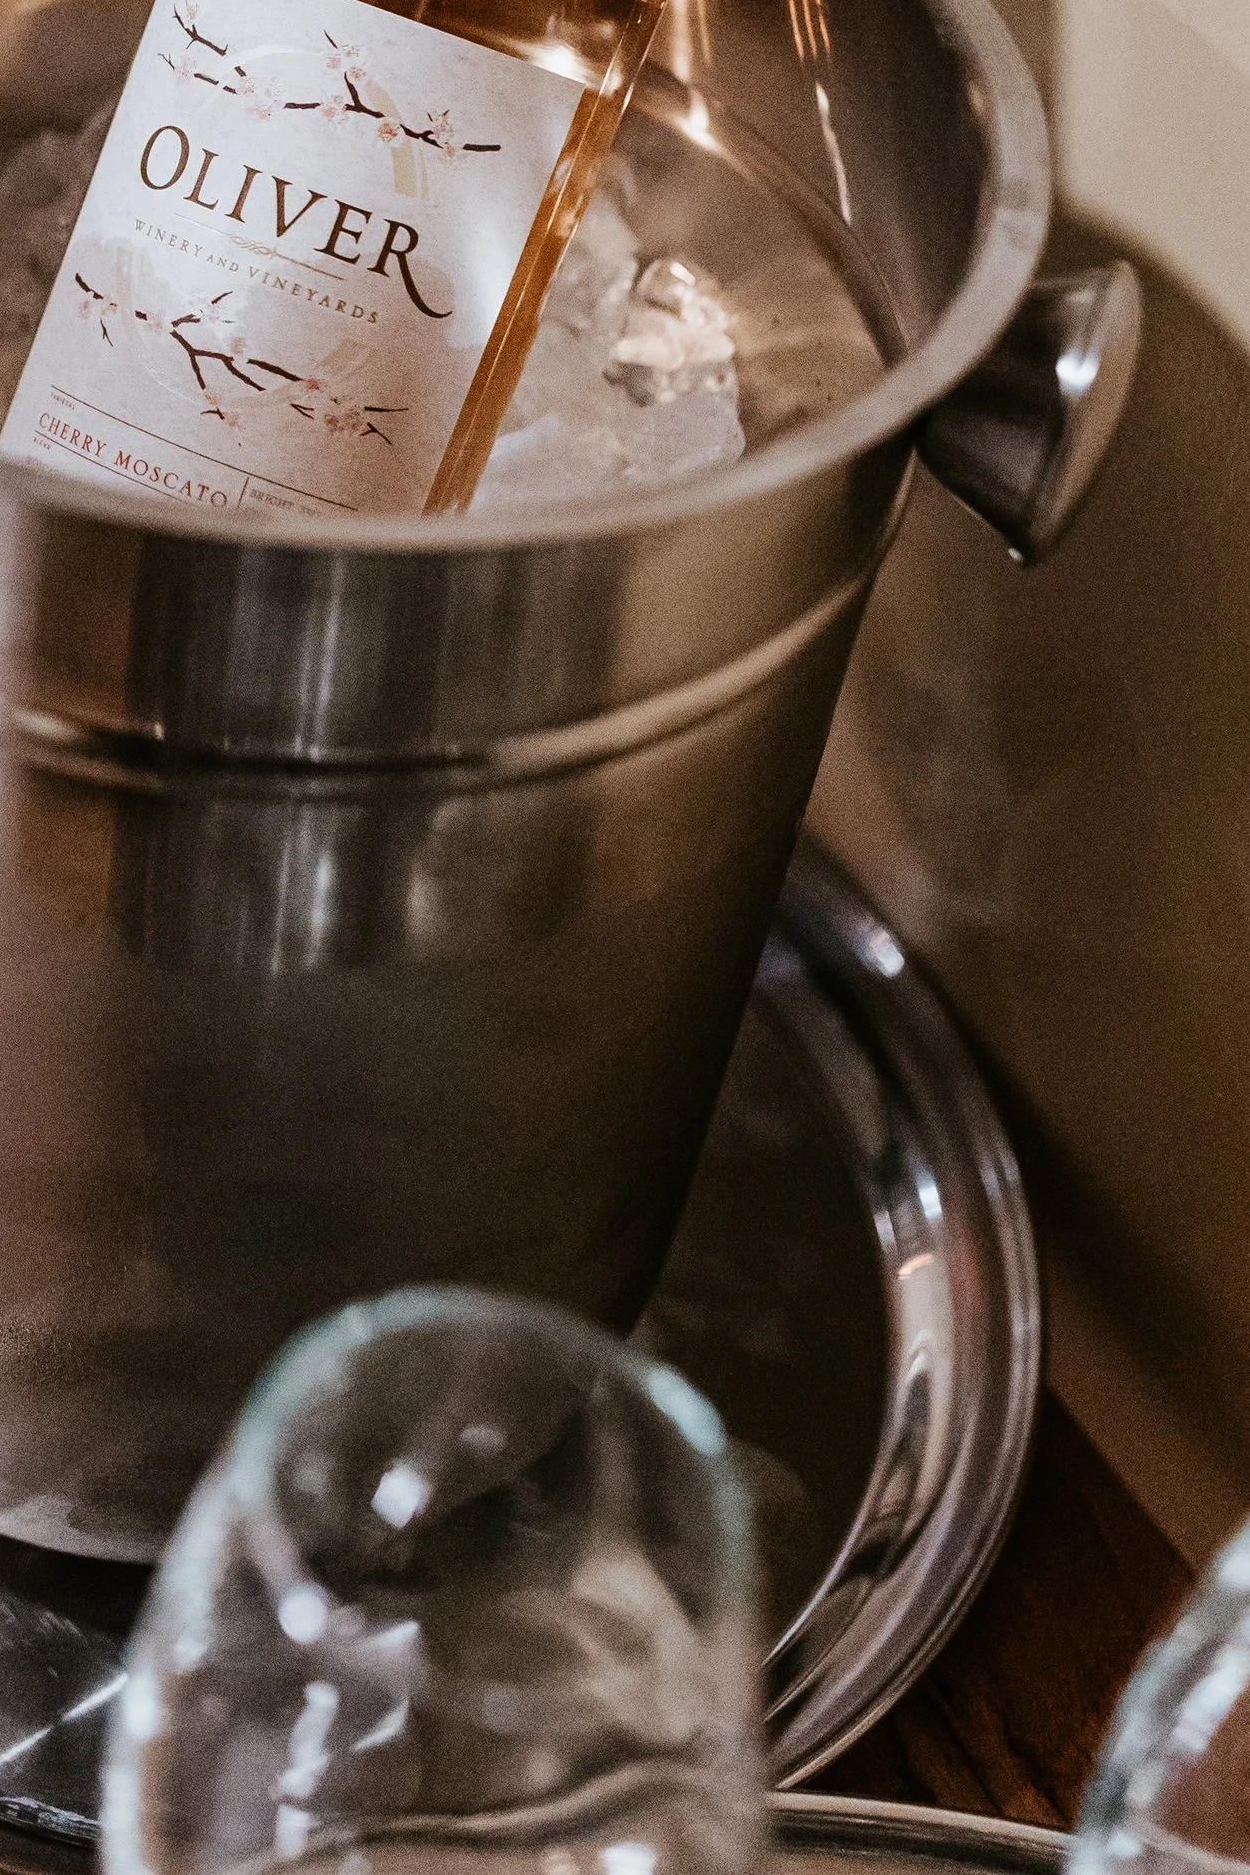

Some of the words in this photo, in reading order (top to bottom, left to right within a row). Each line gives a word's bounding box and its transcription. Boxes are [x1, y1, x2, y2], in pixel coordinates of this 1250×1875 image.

[134, 218, 204, 257] WINERY
[207, 254, 240, 273] AND
[249, 266, 380, 324] VINEYARDS
[139, 125, 452, 319] OLIVER
[38, 412, 107, 458] CHERRY
[113, 450, 228, 509] MOSCATO
[250, 488, 295, 511] BRIGHT
